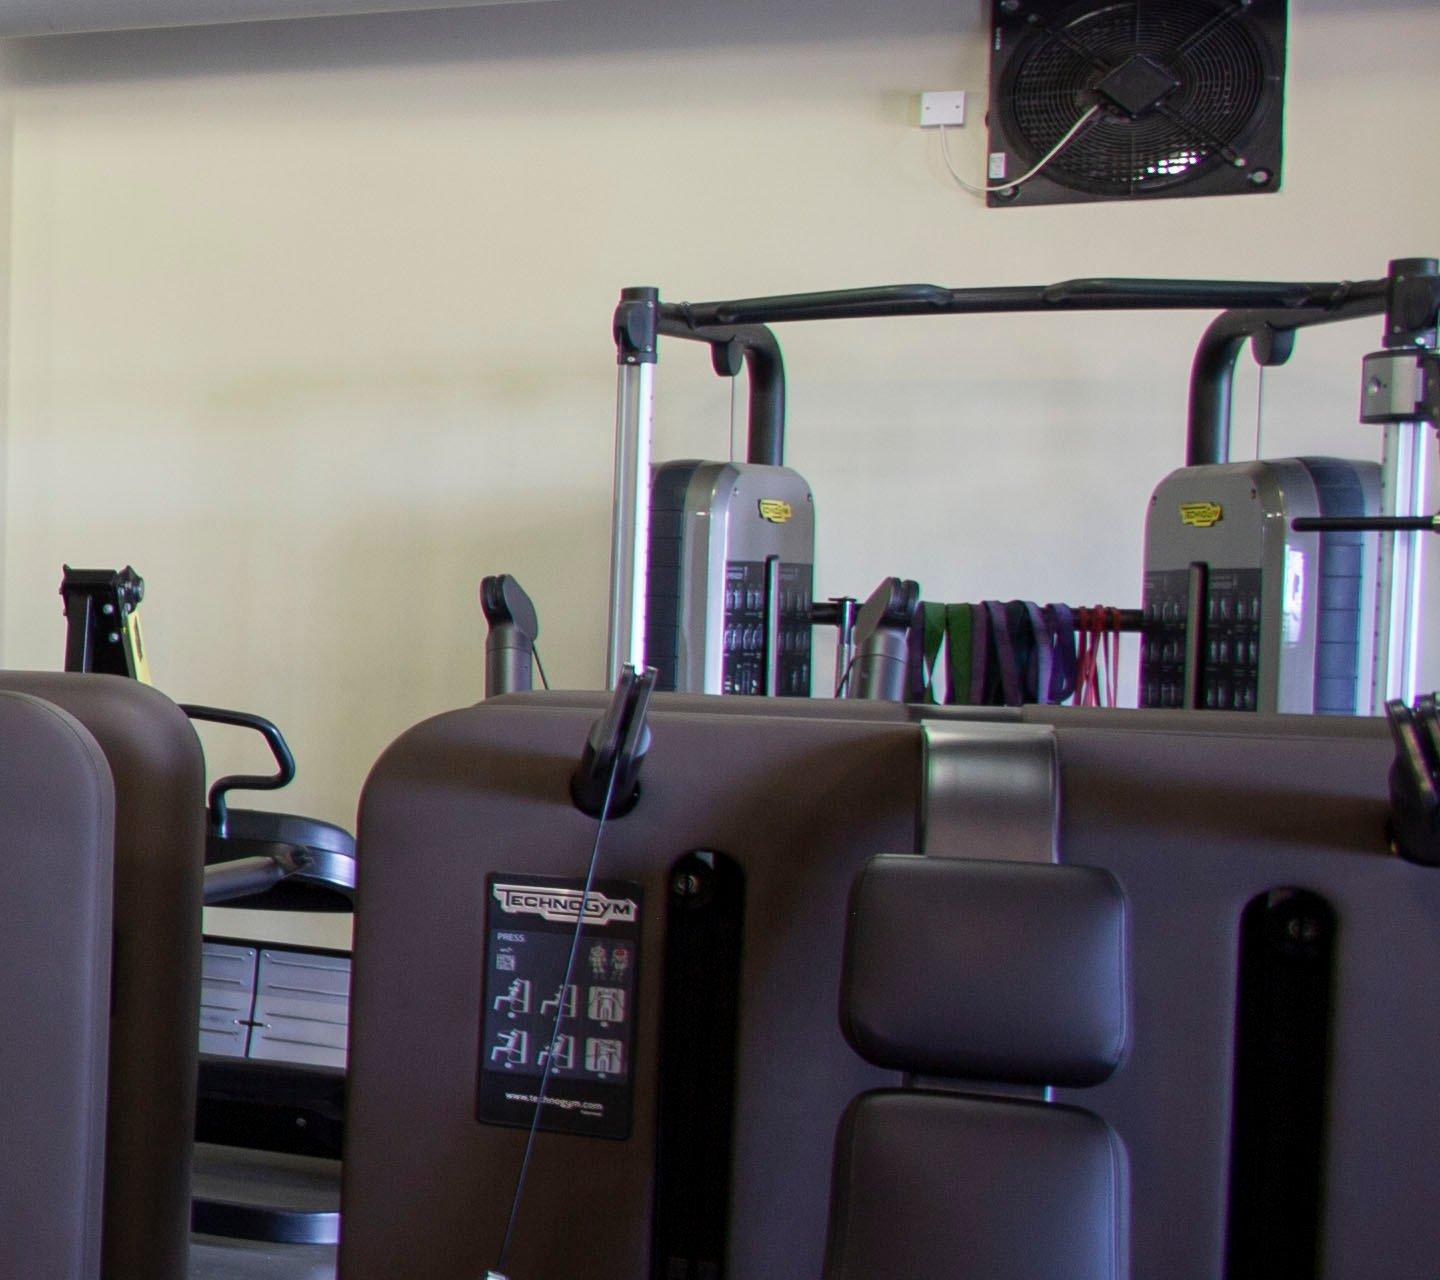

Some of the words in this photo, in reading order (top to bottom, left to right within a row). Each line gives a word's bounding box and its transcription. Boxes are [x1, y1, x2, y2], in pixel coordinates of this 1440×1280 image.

[495, 887, 633, 918] TECHNOGYM
[497, 931, 525, 943] PRESS
[504, 1090, 603, 1111] www.technogym.com
